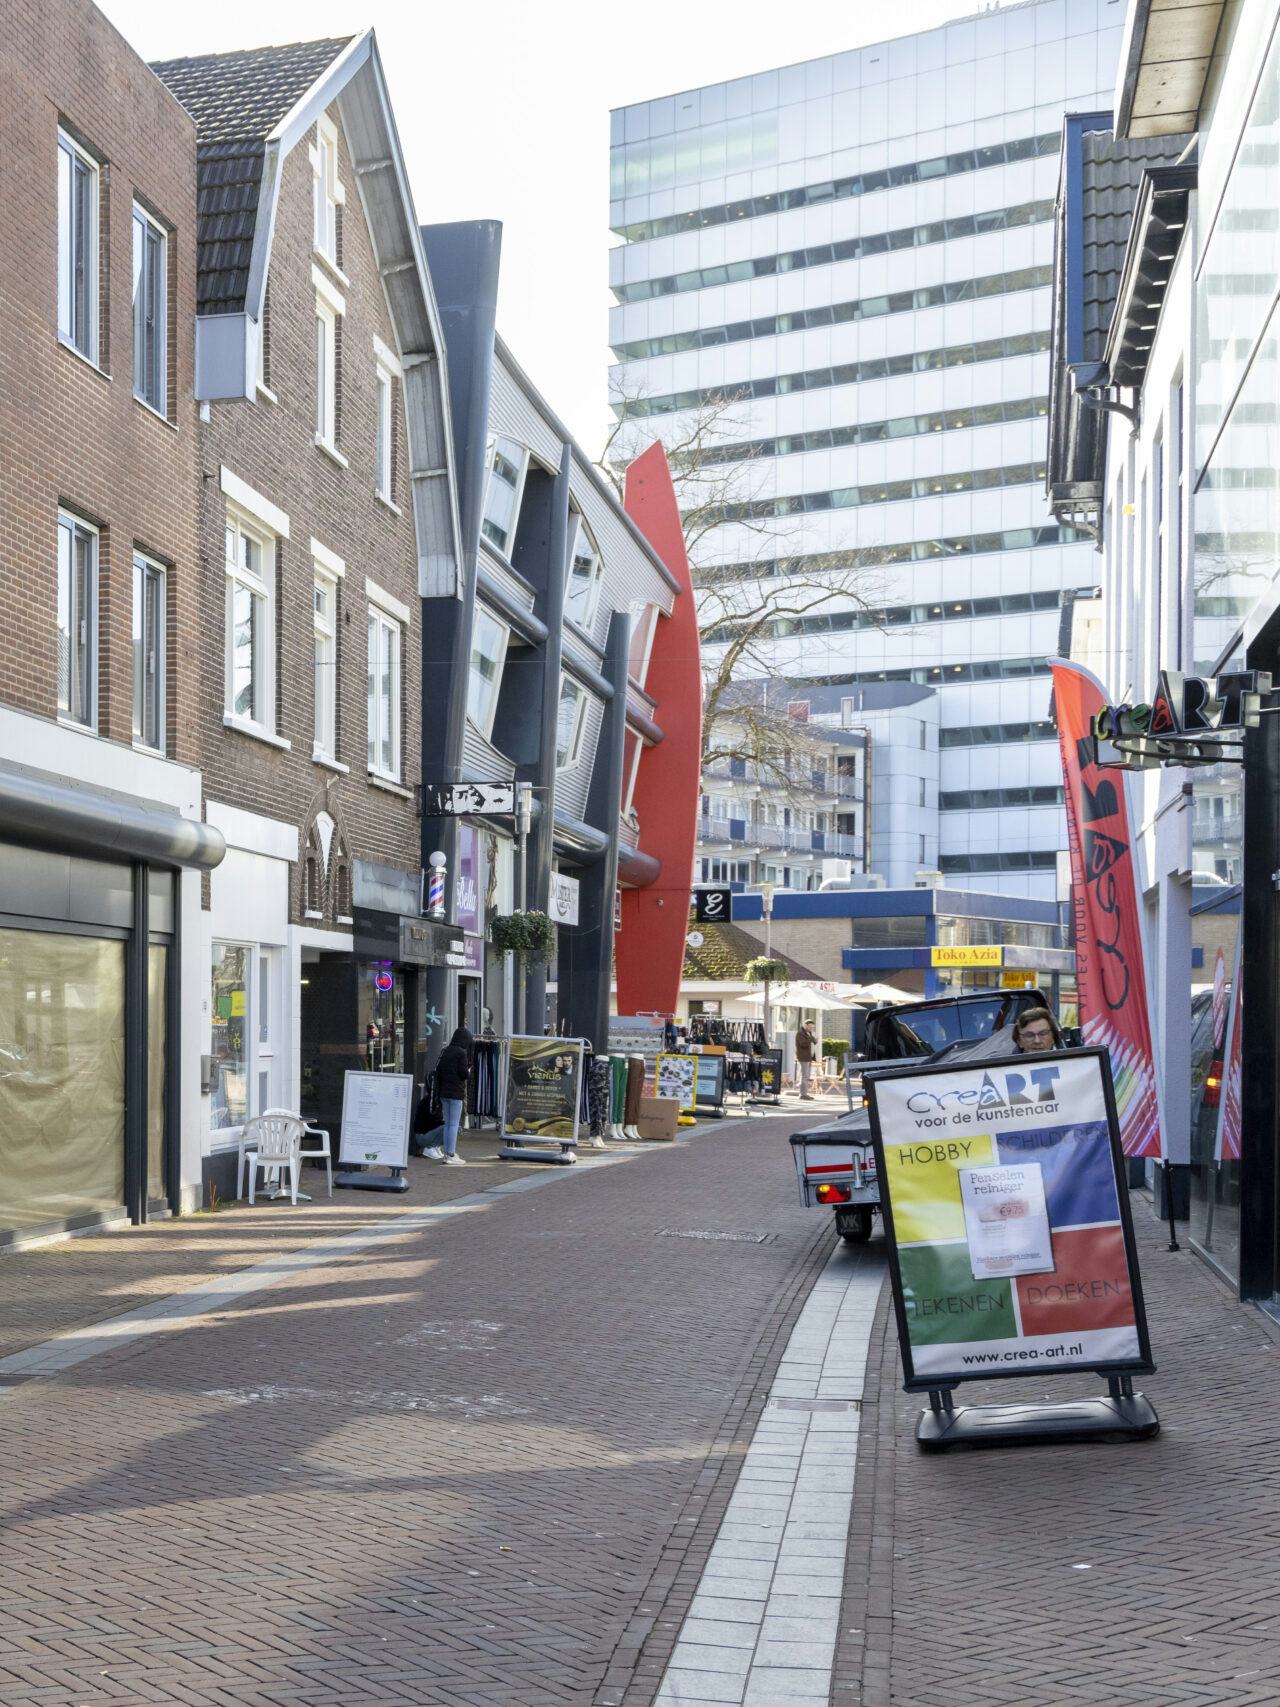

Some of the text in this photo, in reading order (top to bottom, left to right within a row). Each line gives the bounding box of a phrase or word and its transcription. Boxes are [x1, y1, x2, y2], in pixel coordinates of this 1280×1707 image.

[934, 947, 998, 960] Toko Azia
[915, 1102, 1060, 1128] voor de kunstenaar
[996, 1123, 1108, 1147] SCHILDEREN
[899, 1141, 972, 1166] HOBBY
[974, 1182, 1025, 1195] reiniger
[1027, 1280, 1121, 1305] DOEKEN
[912, 1293, 1005, 1317] TEKENEN
[962, 1343, 1083, 1365] www.crea-art.nl
